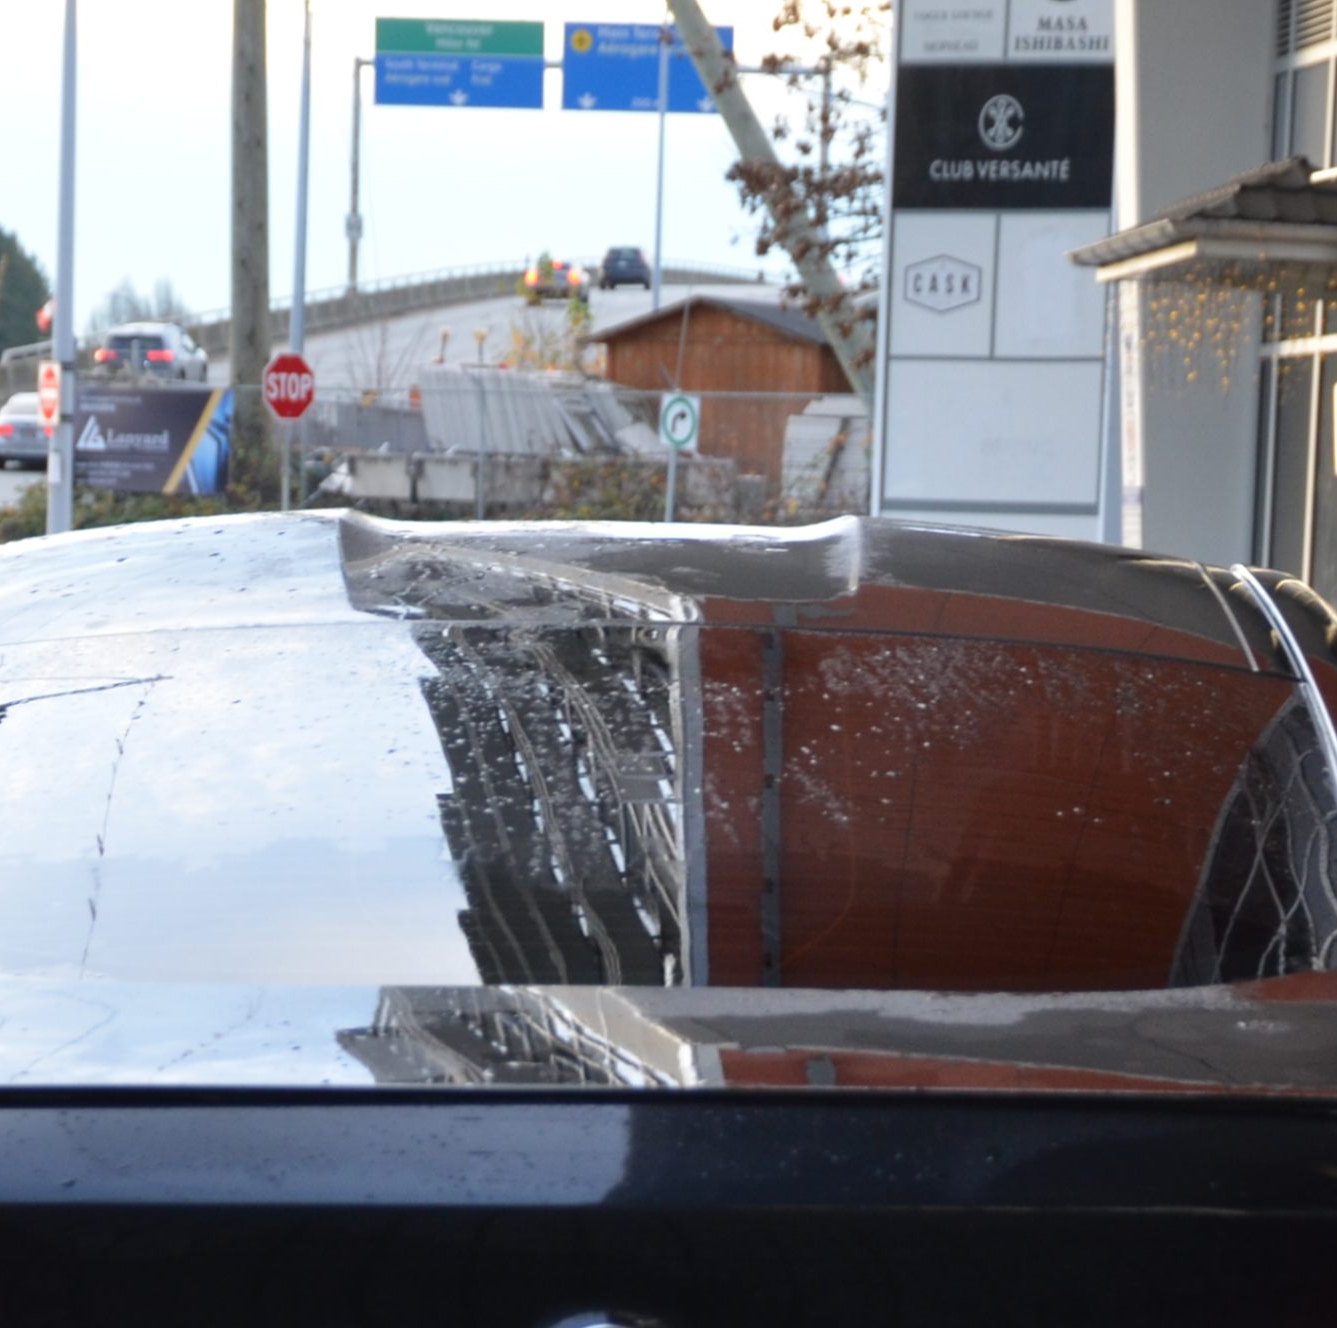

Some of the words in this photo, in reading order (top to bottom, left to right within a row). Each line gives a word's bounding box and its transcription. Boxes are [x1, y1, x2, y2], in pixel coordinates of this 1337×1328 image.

[1037, 16, 1088, 31] MASA
[1014, 36, 1109, 51] ISHIBASHI
[929, 160, 973, 180] CLUB
[977, 156, 1071, 181] VERSANTÉ
[913, 273, 971, 295] CASK
[266, 371, 312, 401] STOP
